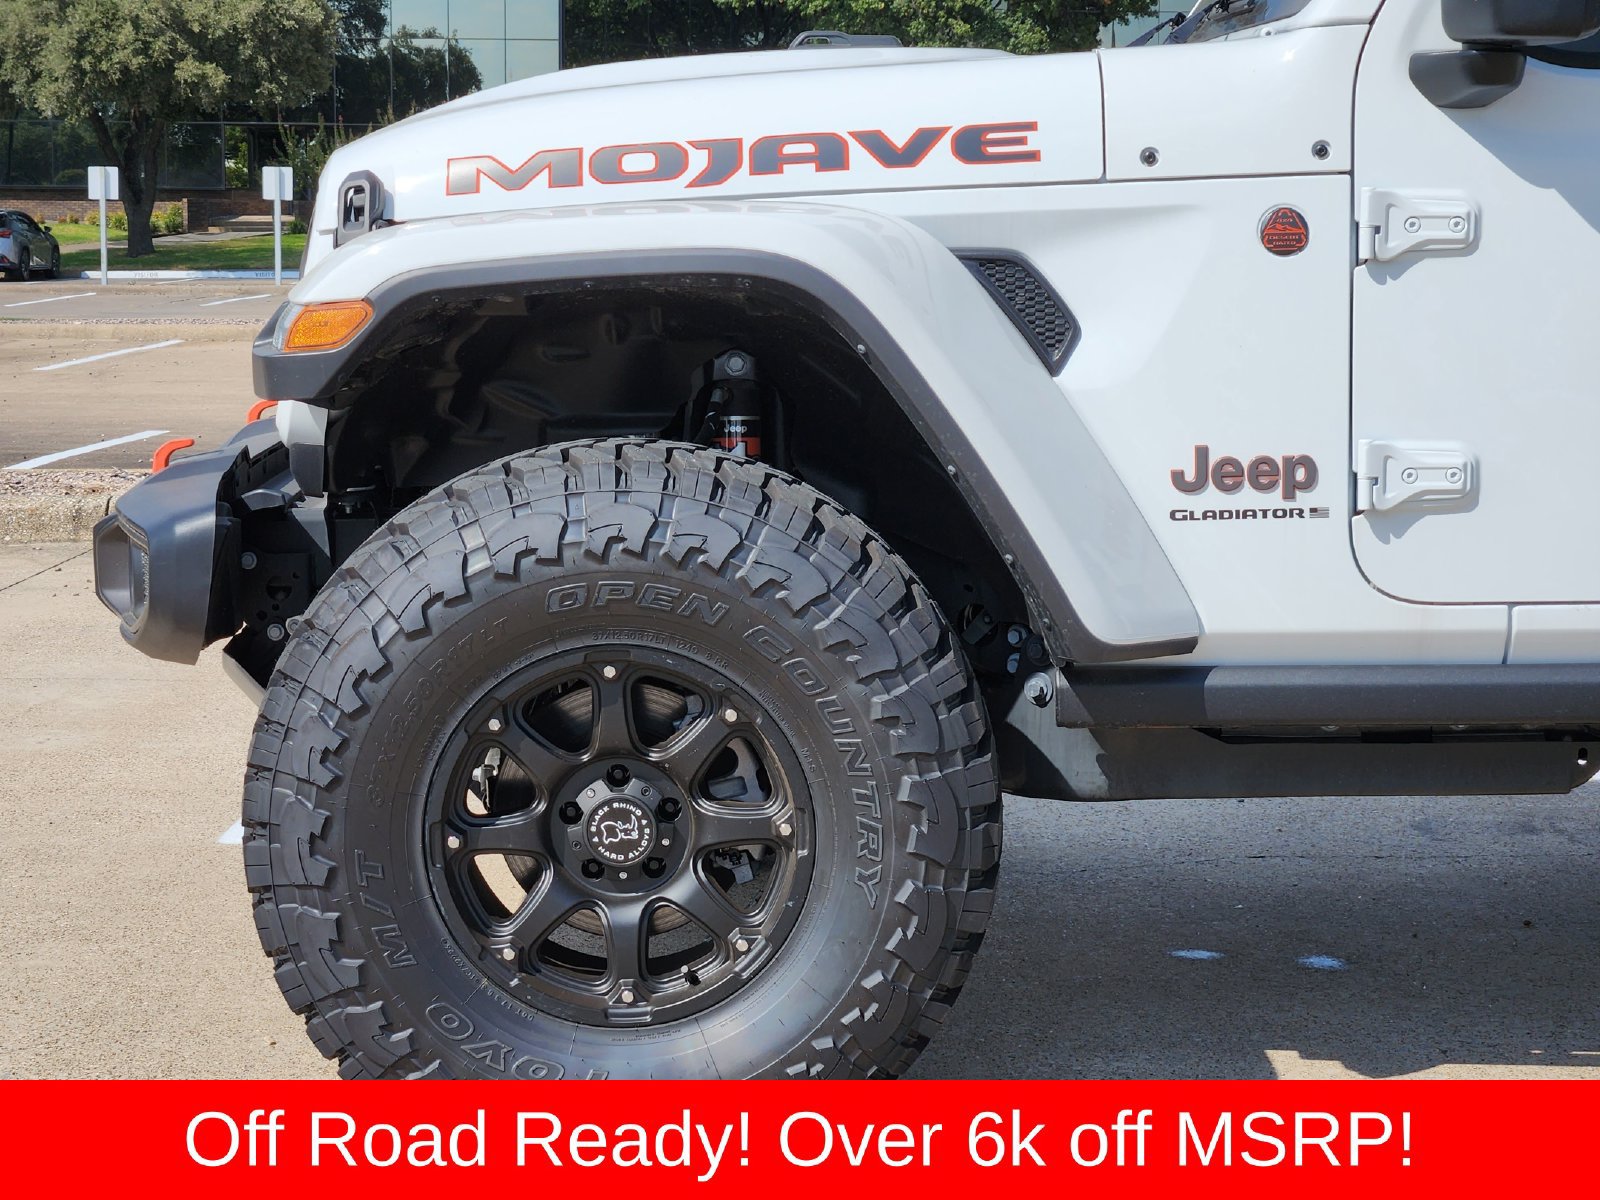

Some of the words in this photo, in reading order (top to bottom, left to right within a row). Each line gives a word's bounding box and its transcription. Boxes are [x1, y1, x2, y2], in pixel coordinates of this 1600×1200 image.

[445, 120, 1042, 196] MOJAVE
[723, 424, 748, 434] Jeep
[1170, 445, 1319, 500] Jeep
[1169, 508, 1306, 521] GLADIATOR
[545, 581, 730, 627] OPEN
[742, 625, 884, 909] COUNTRY
[590, 805, 610, 832] BLACK
[612, 802, 642, 817] RHINO
[597, 846, 625, 860] HARD
[628, 828, 650, 859] ALLOYS
[355, 849, 418, 968] M/T
